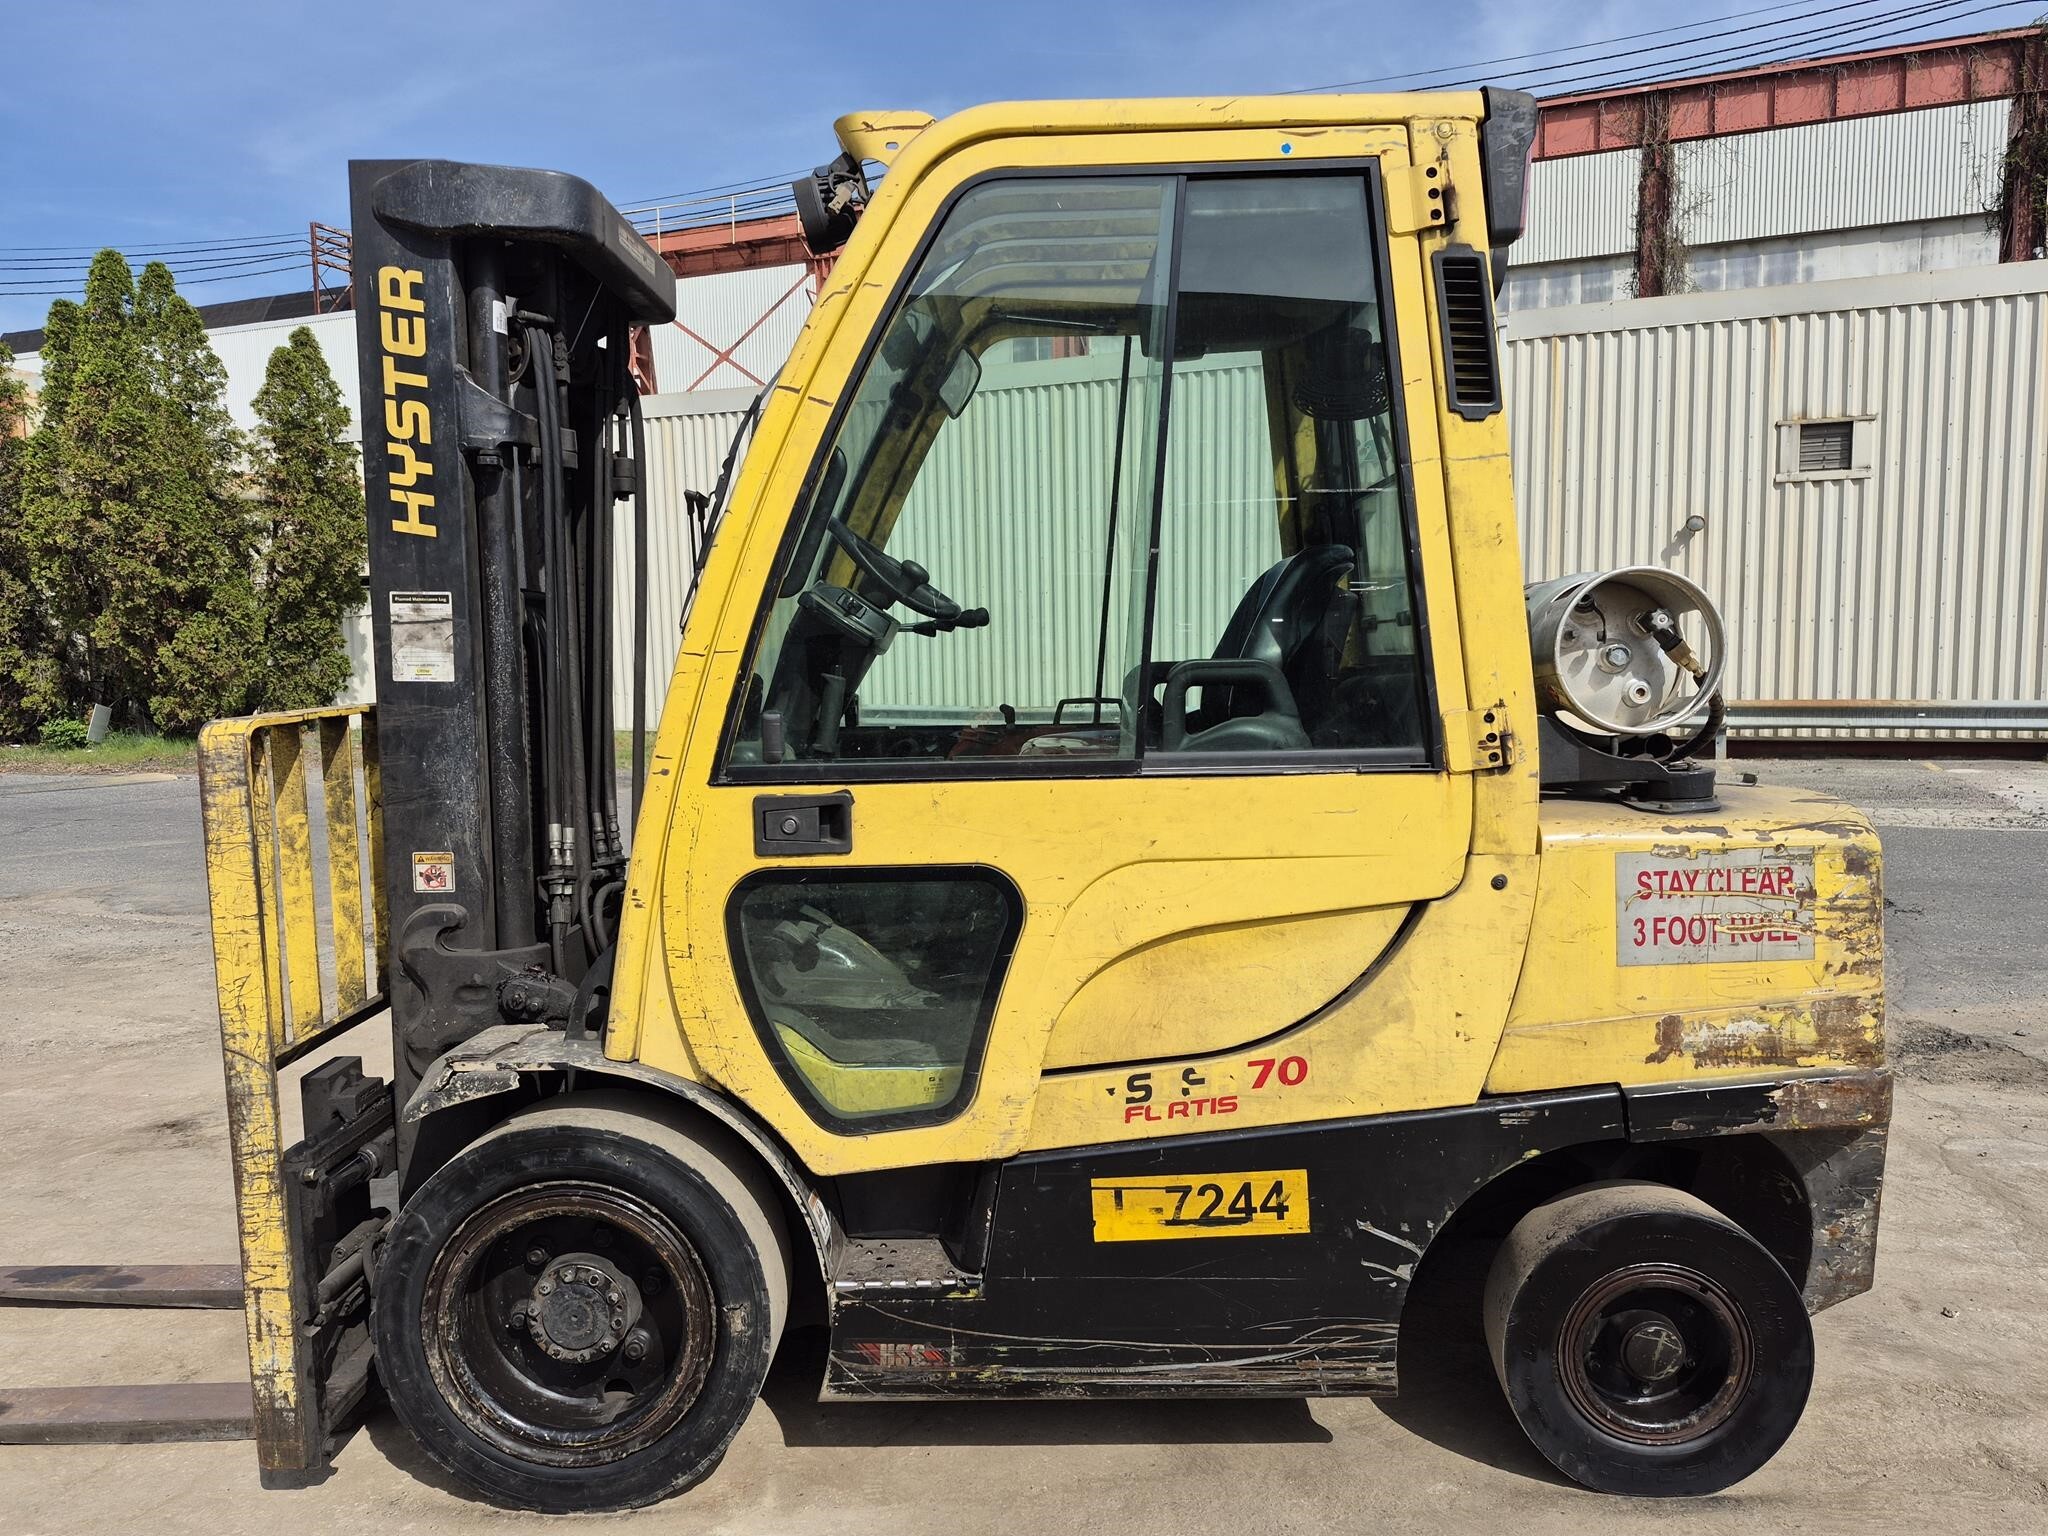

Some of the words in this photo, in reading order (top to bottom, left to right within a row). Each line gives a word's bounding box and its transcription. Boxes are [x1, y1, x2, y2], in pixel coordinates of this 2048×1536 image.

[378, 265, 437, 538] HYSTER
[1637, 869, 1699, 899] STAY
[1707, 865, 1795, 897] CLEAR
[1633, 918, 1646, 947] 3
[1653, 916, 1721, 945] FOOT
[1247, 1055, 1308, 1089] 70
